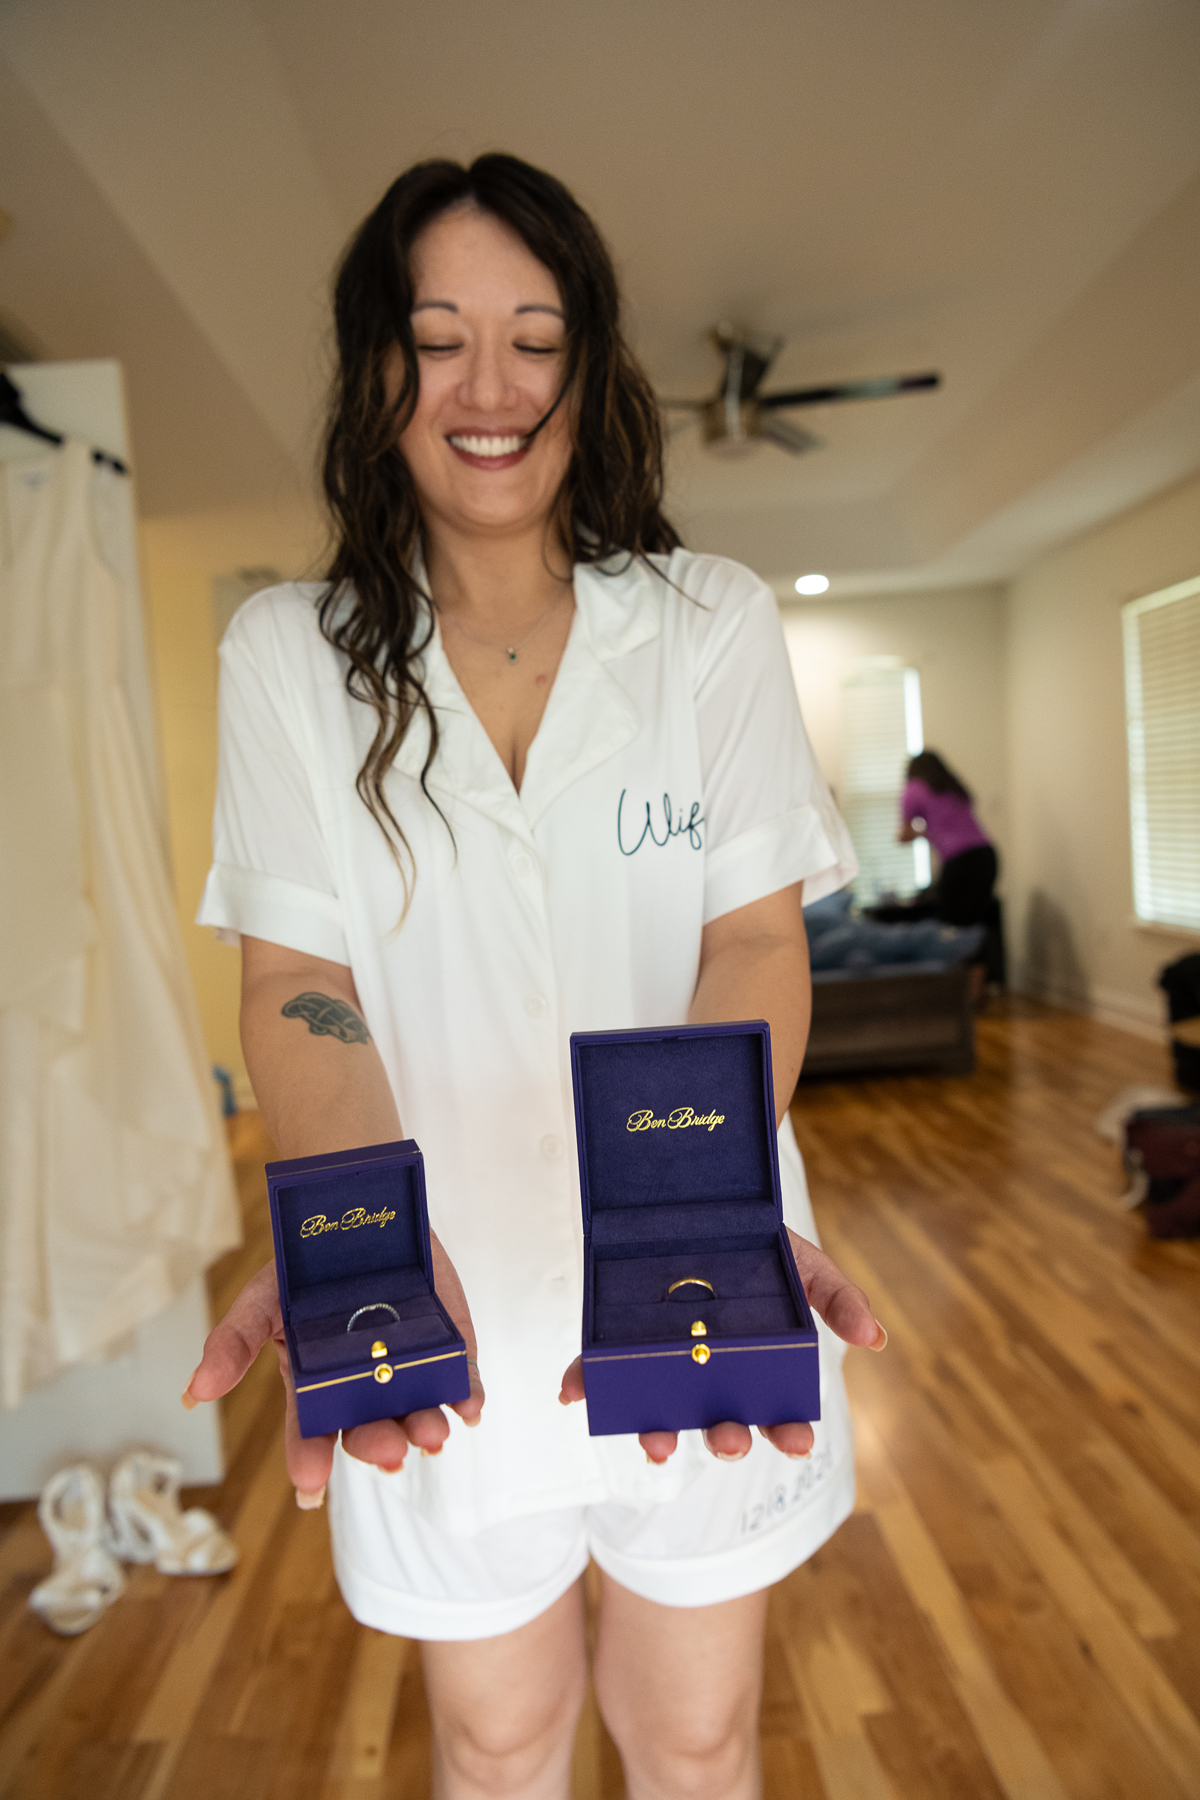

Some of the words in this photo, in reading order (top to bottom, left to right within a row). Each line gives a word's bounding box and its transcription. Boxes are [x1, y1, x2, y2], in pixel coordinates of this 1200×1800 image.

[617, 788, 705, 857] Wif
[626, 1109, 666, 1132] Ben
[667, 1106, 725, 1132] Bridge
[300, 1214, 339, 1239] Ben
[340, 1206, 396, 1230] Bridge
